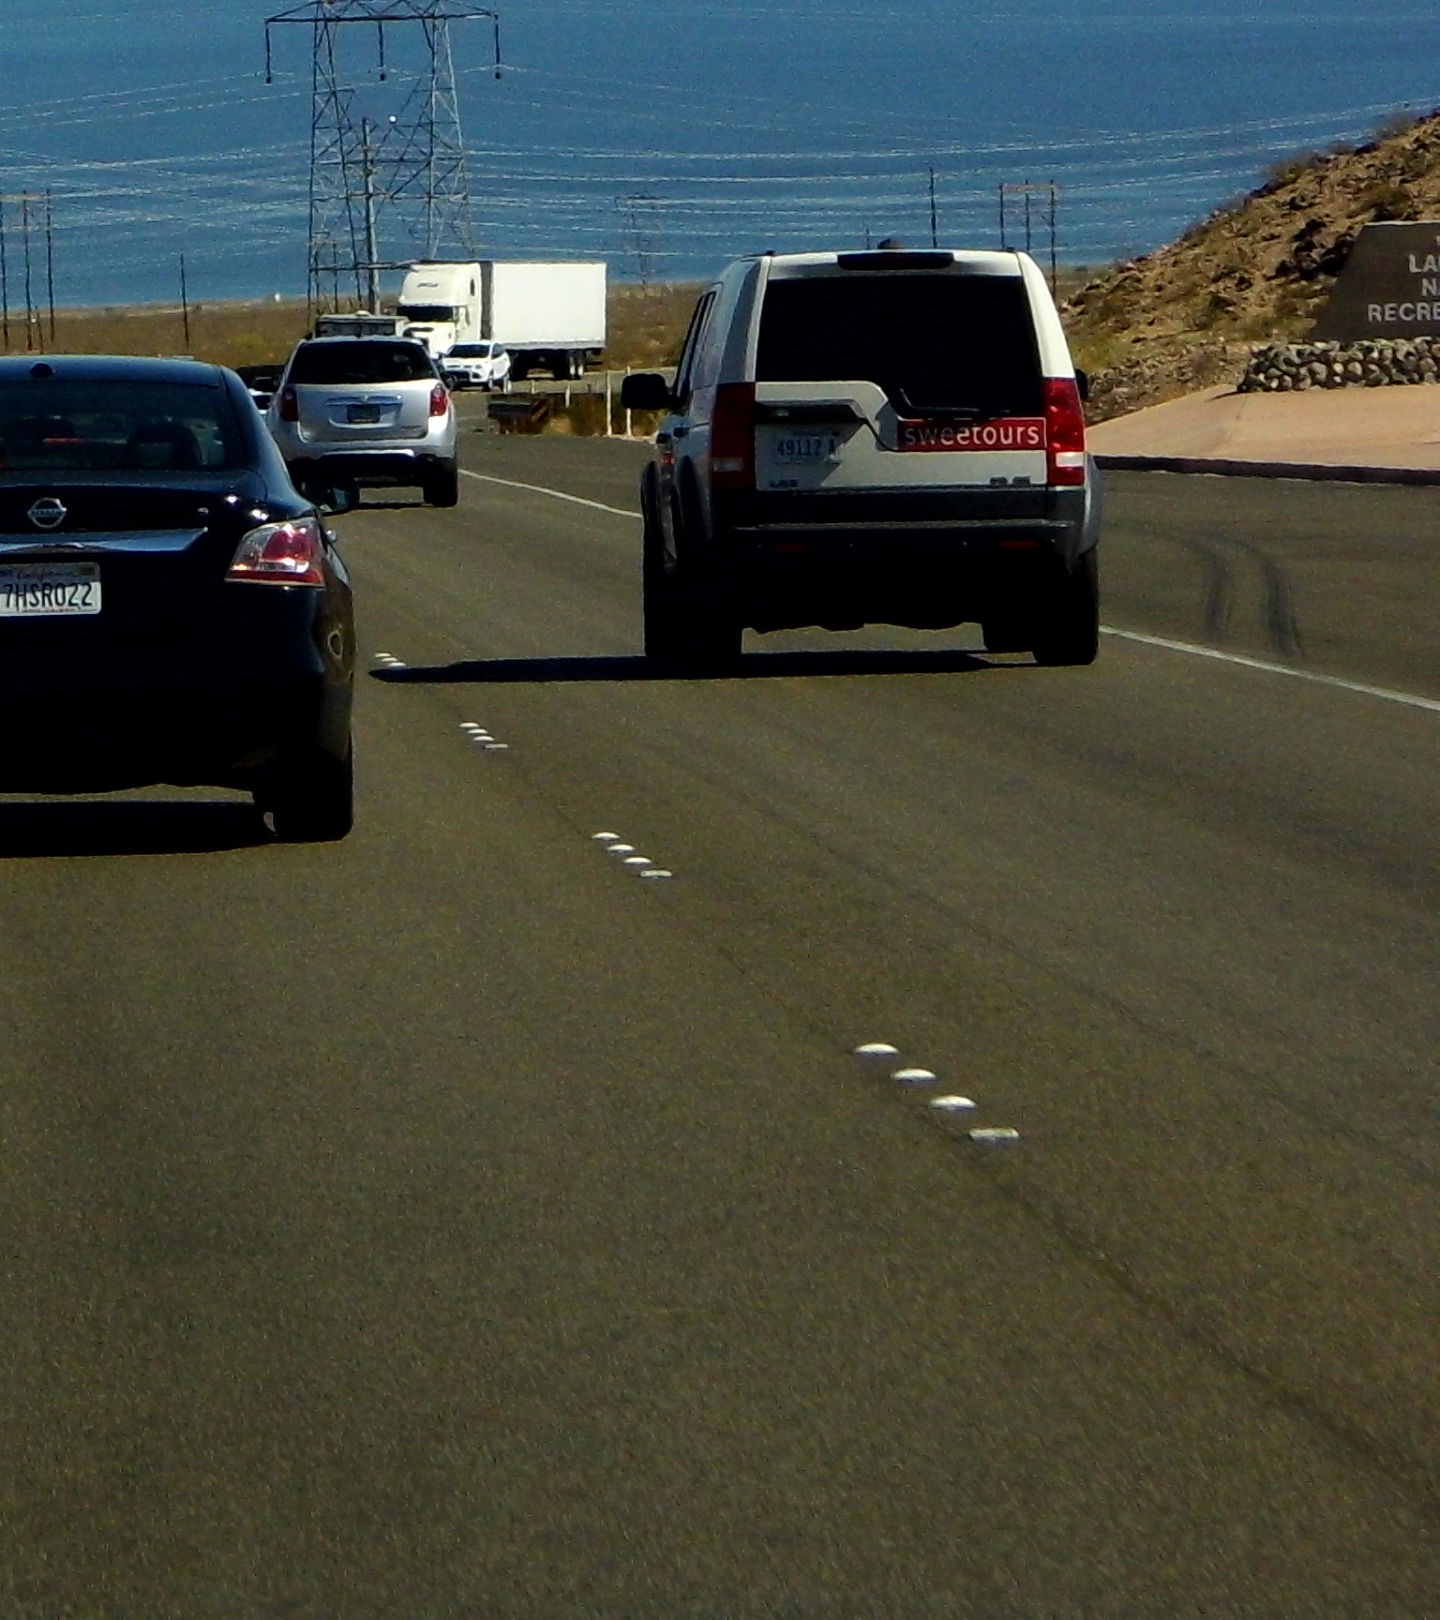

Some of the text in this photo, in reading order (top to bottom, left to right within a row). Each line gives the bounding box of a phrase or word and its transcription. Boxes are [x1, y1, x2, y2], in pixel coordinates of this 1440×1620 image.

[1408, 254, 1440, 273] LA
[904, 423, 1040, 445] sweetours
[3, 582, 93, 609] 7HSR022
